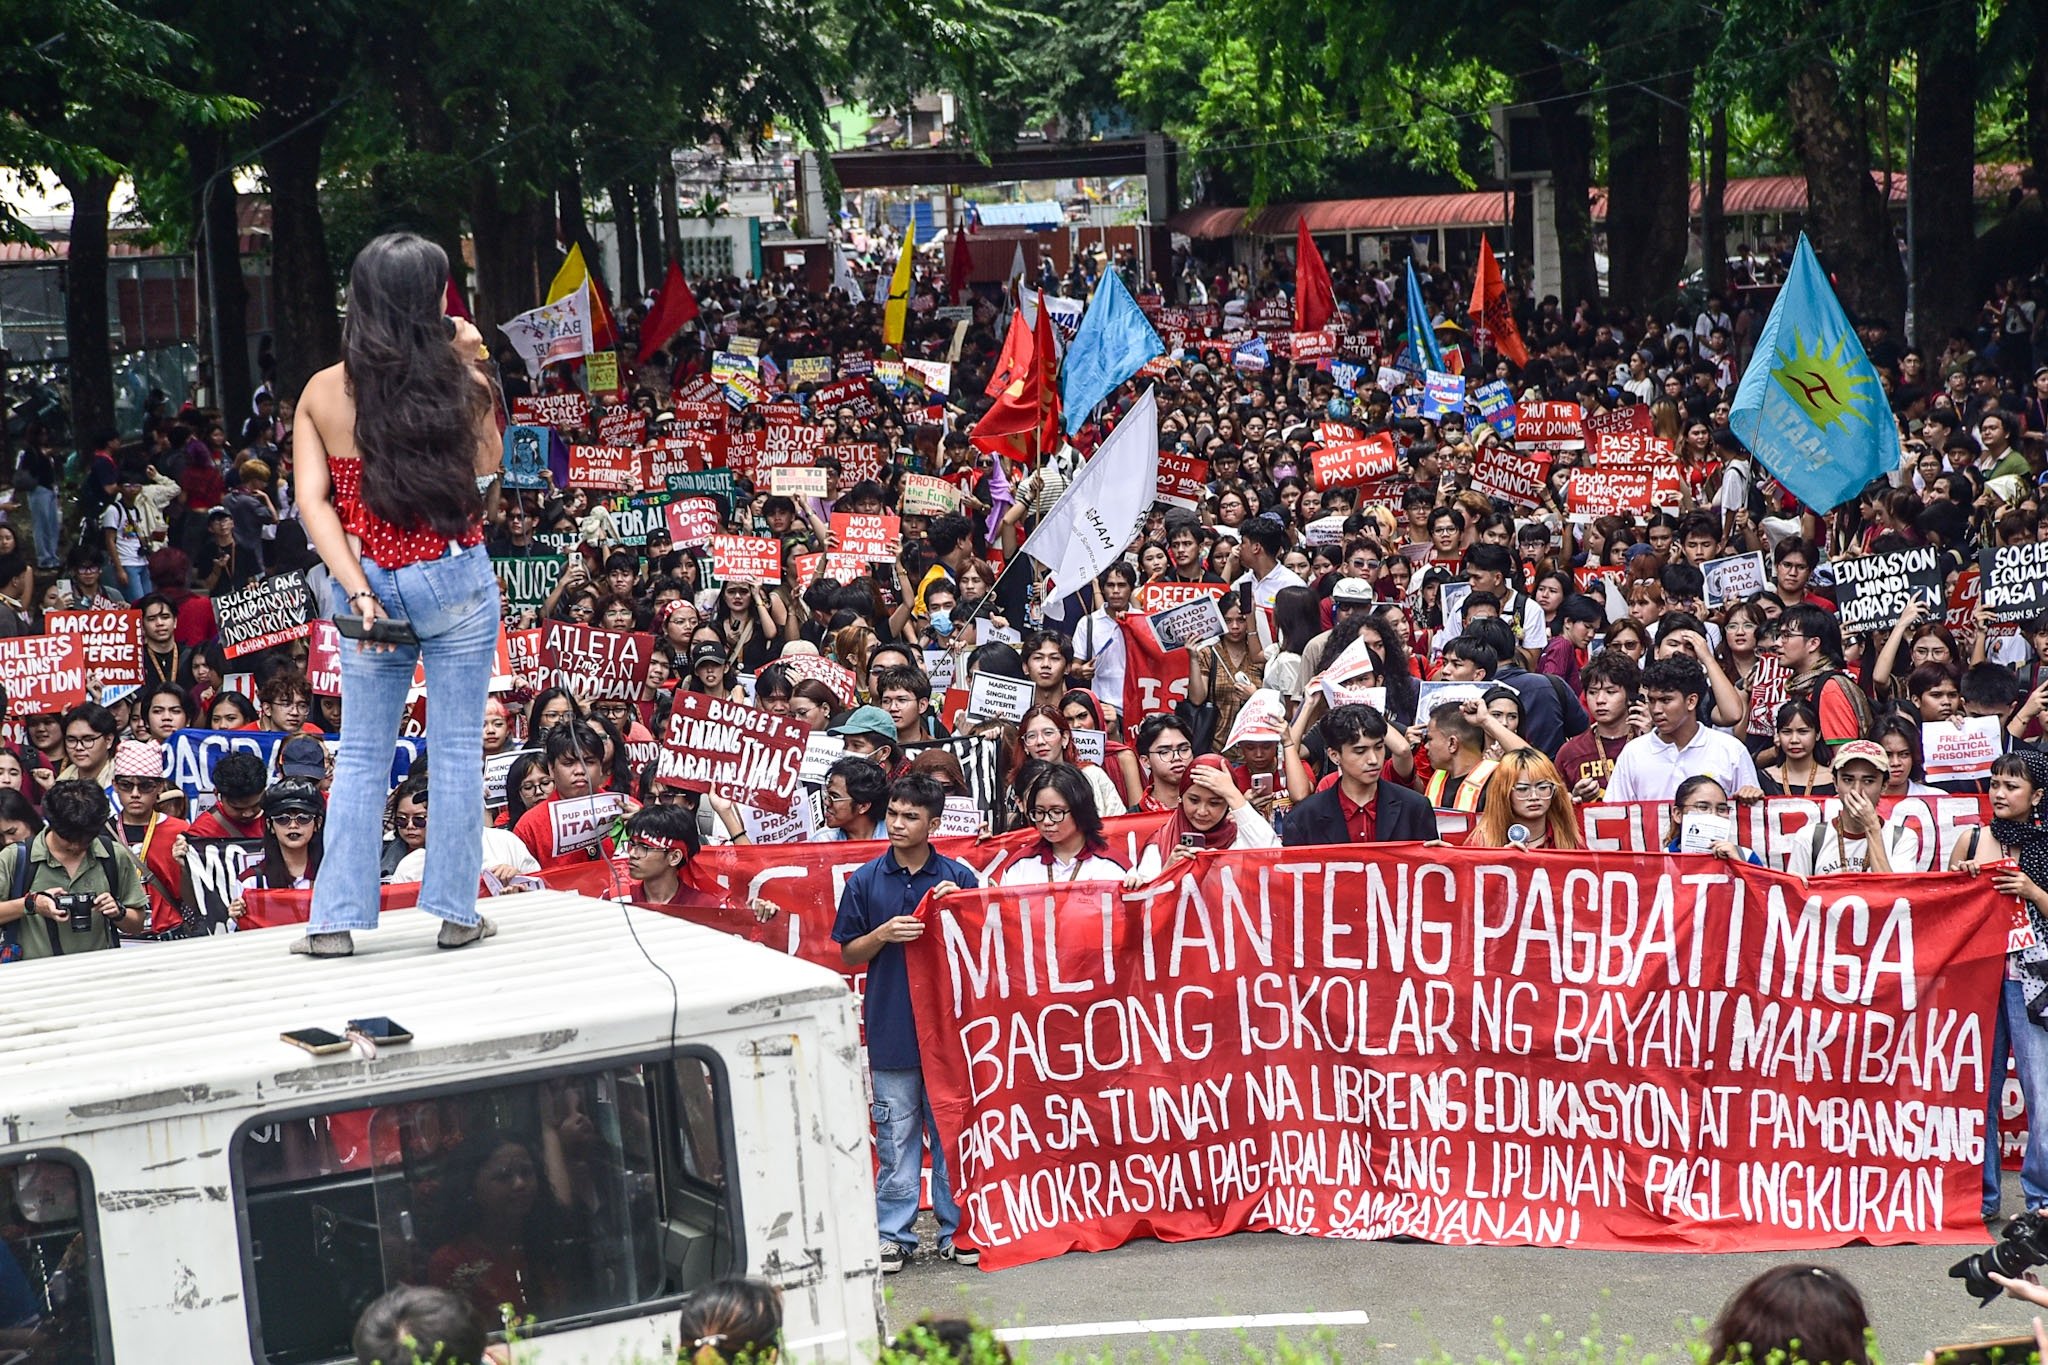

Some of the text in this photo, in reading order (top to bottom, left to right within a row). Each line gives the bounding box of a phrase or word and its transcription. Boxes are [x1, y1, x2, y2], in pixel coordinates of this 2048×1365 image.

[1520, 401, 1573, 420] SHUT THE
[1587, 407, 1635, 430] DEFEND
[768, 425, 815, 443] NO TO
[1325, 423, 1354, 440] NO TO
[1518, 421, 1582, 437] PAX DOWN
[731, 432, 757, 446] NO TO
[1601, 434, 1640, 452] PASS
[576, 446, 623, 460] DOWN
[653, 448, 685, 463] NO TO
[1318, 440, 1384, 469] SHUT THE
[1483, 446, 1541, 479] IMPEACH
[588, 459, 612, 468] WITH
[651, 460, 689, 477] BOGUS
[1321, 456, 1394, 486] PAX DOWN
[1575, 483, 1646, 500] EDUKASYON!
[615, 511, 645, 537] FOR
[850, 516, 882, 528] NO TO
[845, 527, 887, 541] BOGUS
[714, 535, 778, 555] MARCOS
[842, 540, 894, 556] NPU BILL
[714, 556, 778, 571] DUTERTE
[1723, 561, 1756, 575] NO TO
[1832, 546, 1937, 586] EDUKASYON
[1725, 579, 1761, 593] SILICA
[1729, 572, 1752, 584] PAX
[1855, 573, 1910, 598] HINDI
[216, 571, 302, 610] ISULONG ANG
[1146, 585, 1225, 602] DEFEND
[1984, 581, 2036, 608] IPASA
[1840, 583, 1942, 623] KORAPSYN
[50, 612, 130, 635] MARCOS
[1169, 605, 1207, 624] SAHOD
[1172, 614, 1205, 630] ITAAS
[1174, 616, 1218, 637] PRESYO
[235, 638, 267, 656] AGHAM
[545, 623, 640, 664] ATLETA
[996, 632, 1011, 643] TECH
[0, 635, 73, 661] THLETES
[931, 659, 951, 667] STOP
[3, 667, 82, 700] RUPTION
[537, 665, 643, 701] PONDOHAN
[988, 680, 1018, 692] MARCOS
[984, 698, 1016, 710] DUTERTE
[707, 699, 784, 738] BUDGET
[667, 712, 743, 754] SINTANG
[1967, 732, 1987, 741] ALL
[1932, 748, 1994, 761] PRISONERS!
[1937, 741, 1991, 752] POLITICAL
[655, 746, 737, 785] PAARALAN
[720, 785, 760, 807] CHK
[562, 804, 619, 821] PUP BUDGET
[761, 809, 798, 832] PRESS
[963, 816, 977, 824] SA
[756, 820, 804, 844] FREEDOM
[940, 861, 1457, 1019] MILITANTENG
[1473, 863, 1746, 988] PAGBATI
[1758, 883, 1918, 1012] MGA
[959, 971, 1985, 1107] BAGONG ISKOLAR NG BAYAN! MAKIBAKA
[957, 1103, 1040, 1192] PARA
[1045, 1093, 1100, 1150] SA
[1099, 1071, 1234, 1146] TUNAY
[1245, 1064, 1303, 1125] NA
[1311, 1063, 1468, 1134] LIBRENG
[1474, 1066, 1690, 1152] EDUKASYON
[1697, 1085, 1743, 1151] AT
[1748, 1087, 1985, 1166] PAMBANSANG
[1208, 1128, 1378, 1202] PAG-ARALAN
[1383, 1135, 1451, 1198] ANG
[1465, 1139, 1628, 1208] LIPUNAN
[1644, 1154, 1944, 1233] PAGLINGKURAN
[1248, 1186, 1582, 1245] ANG SAMBAYANAN!
